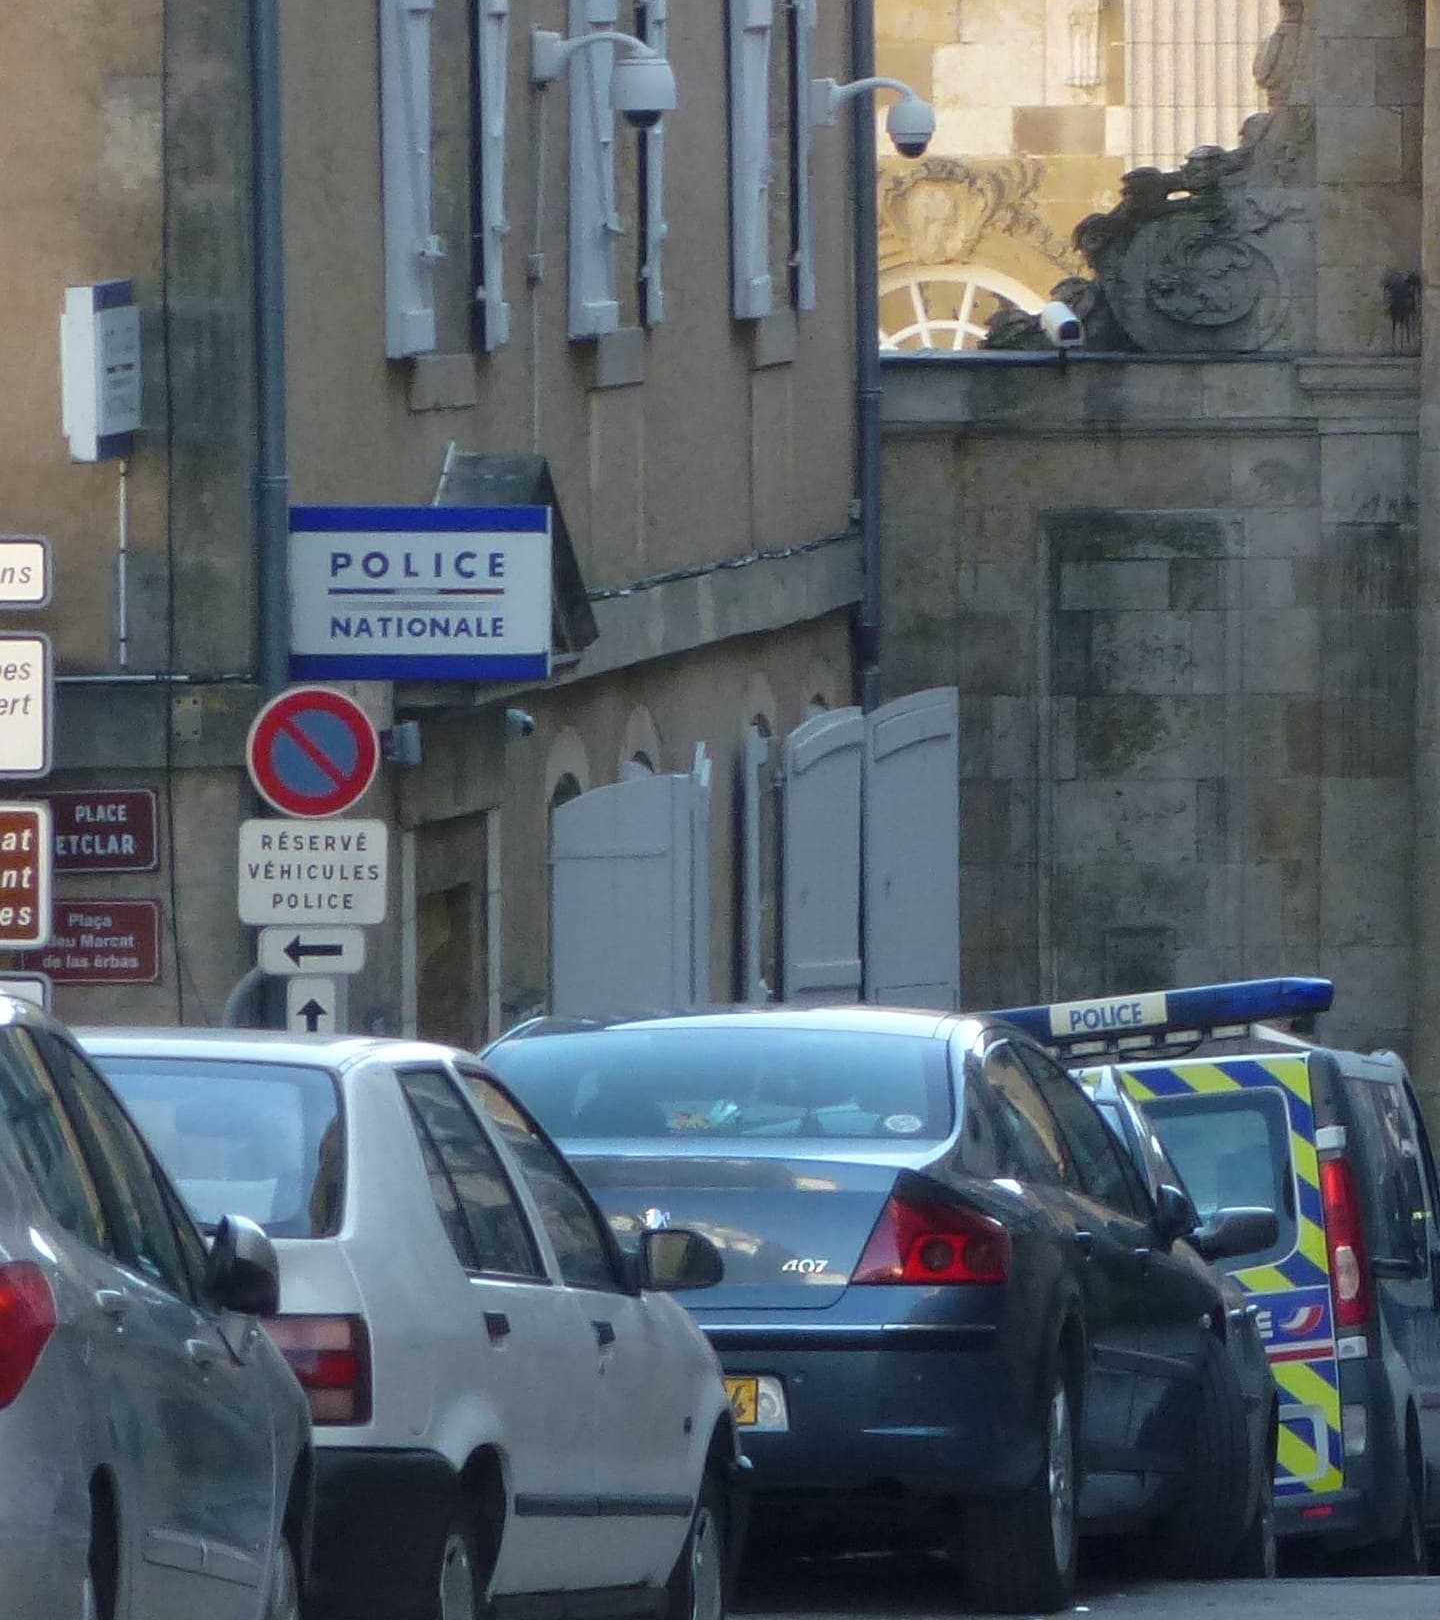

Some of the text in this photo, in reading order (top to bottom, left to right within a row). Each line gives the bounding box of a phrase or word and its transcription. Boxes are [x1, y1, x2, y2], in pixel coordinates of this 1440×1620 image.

[330, 551, 505, 578] POLICE
[330, 617, 504, 638] NATIONALE
[75, 804, 127, 822] PLACE
[56, 834, 135, 855] ETCLAR
[261, 832, 367, 851] RÉSERVÉ
[248, 861, 379, 880] VÉHICULES
[272, 893, 354, 909] POLICE
[1069, 1003, 1142, 1031] POLICE
[781, 1259, 828, 1273] 407
